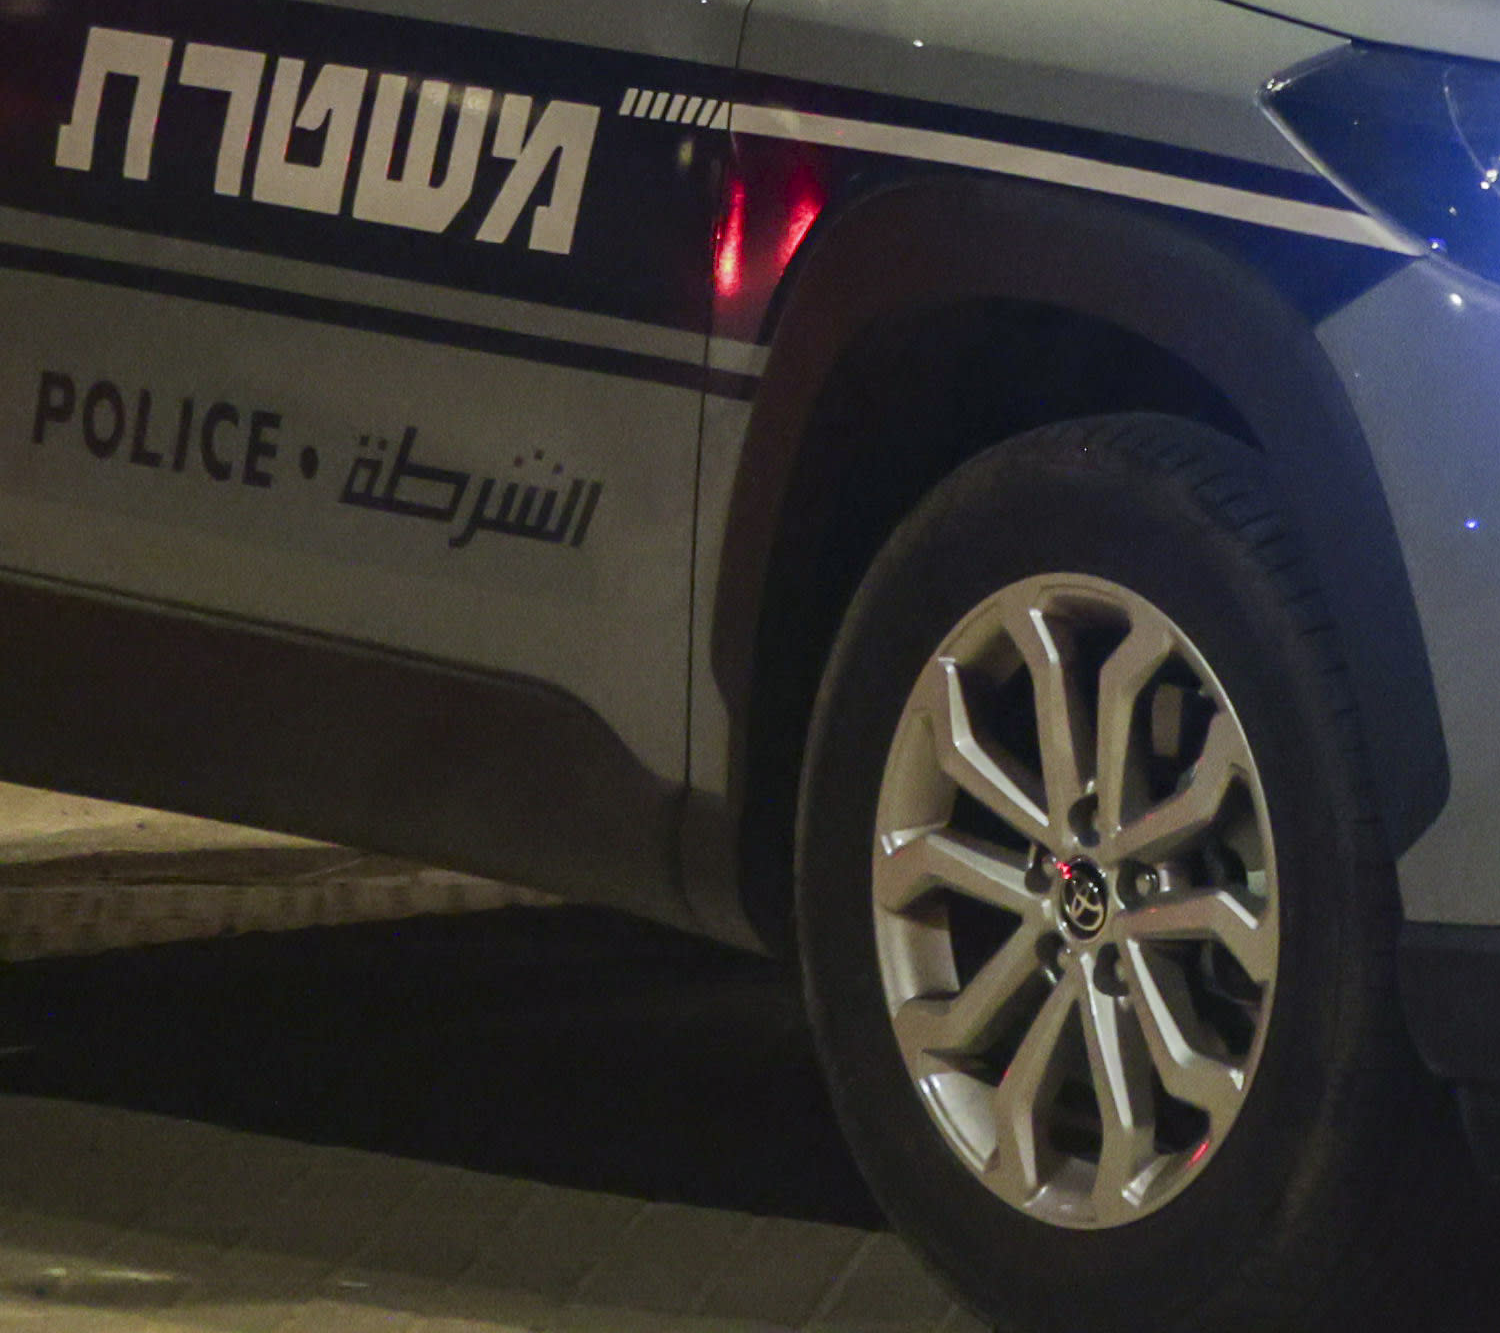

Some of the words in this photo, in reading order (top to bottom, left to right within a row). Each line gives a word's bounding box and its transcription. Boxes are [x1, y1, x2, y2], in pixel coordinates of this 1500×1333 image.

[53, 26, 601, 254] משטרת
[32, 370, 283, 488] POLICE
[338, 426, 602, 548] الشرطة
